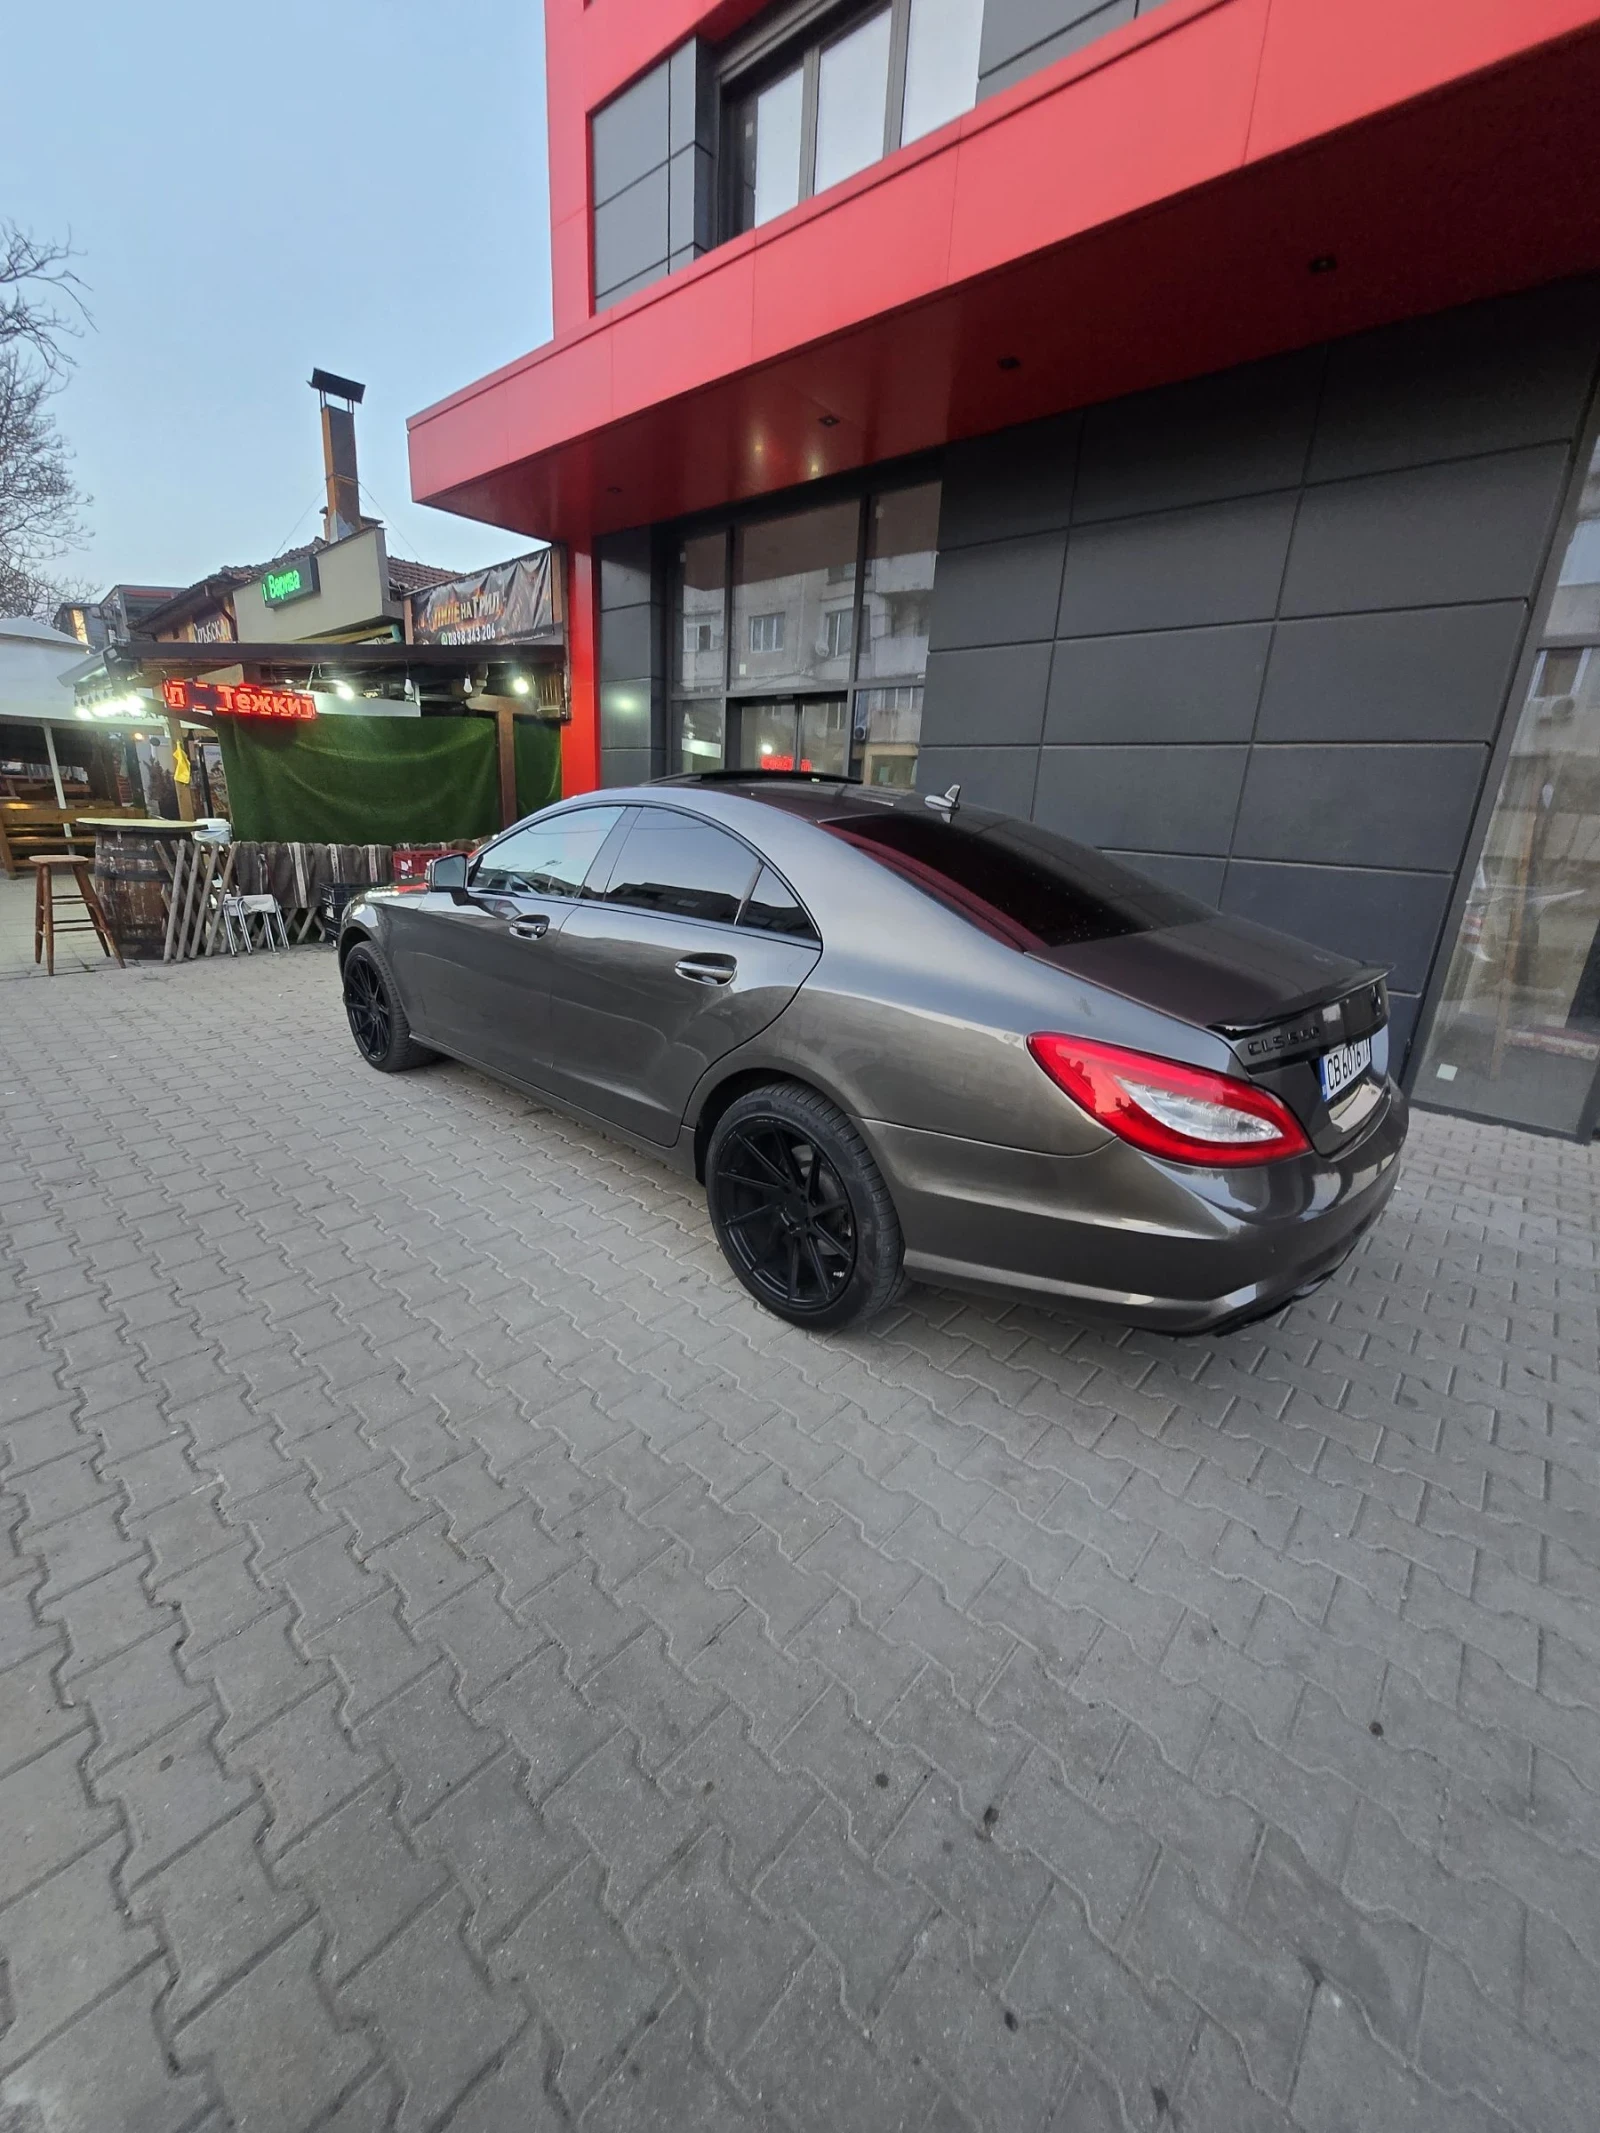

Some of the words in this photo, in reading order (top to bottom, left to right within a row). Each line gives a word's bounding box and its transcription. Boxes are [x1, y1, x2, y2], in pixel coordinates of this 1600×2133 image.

[460, 601, 472, 619] НА
[447, 628, 466, 645] 0898
[467, 627, 480, 643] 343
[482, 622, 496, 640] 206
